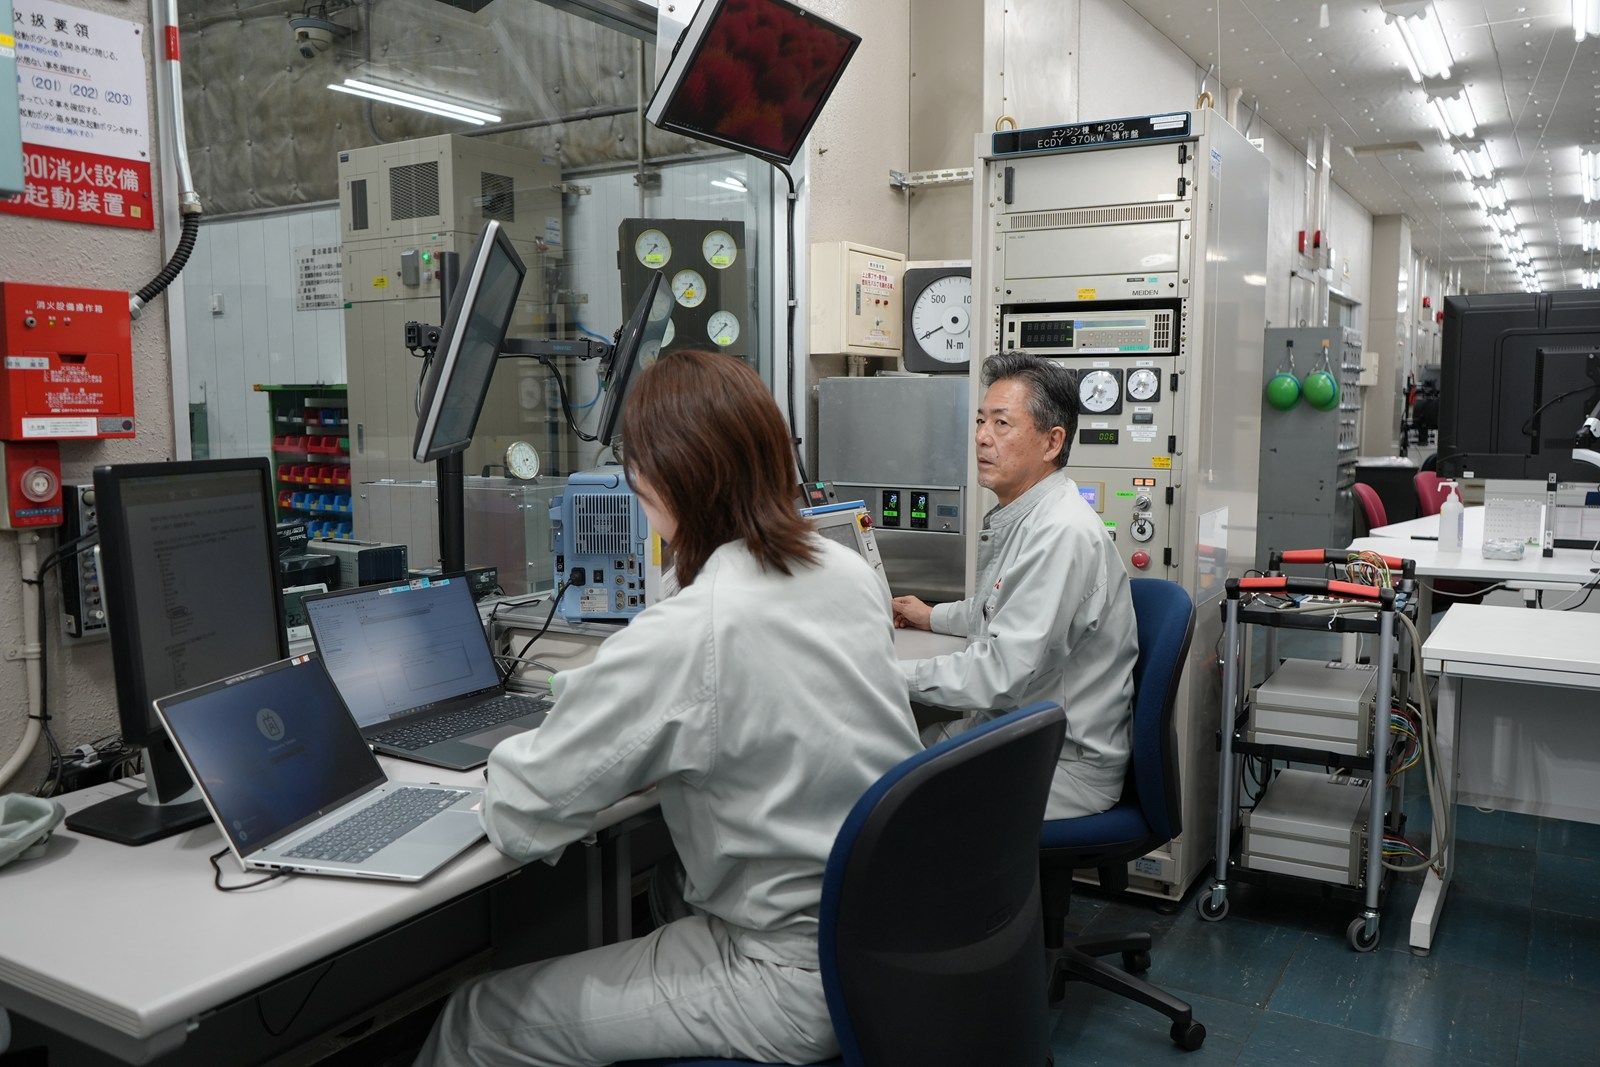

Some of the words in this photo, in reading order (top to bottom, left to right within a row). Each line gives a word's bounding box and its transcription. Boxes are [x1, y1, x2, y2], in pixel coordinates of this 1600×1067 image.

[1052, 126, 1090, 138] エンジン棟
[1097, 122, 1125, 132] #202
[1037, 138, 1064, 148] ECDY
[1070, 134, 1105, 145] 370kW
[1112, 129, 1139, 140] 操作盤
[1131, 289, 1159, 297] MEIDEN
[931, 295, 946, 304] 500
